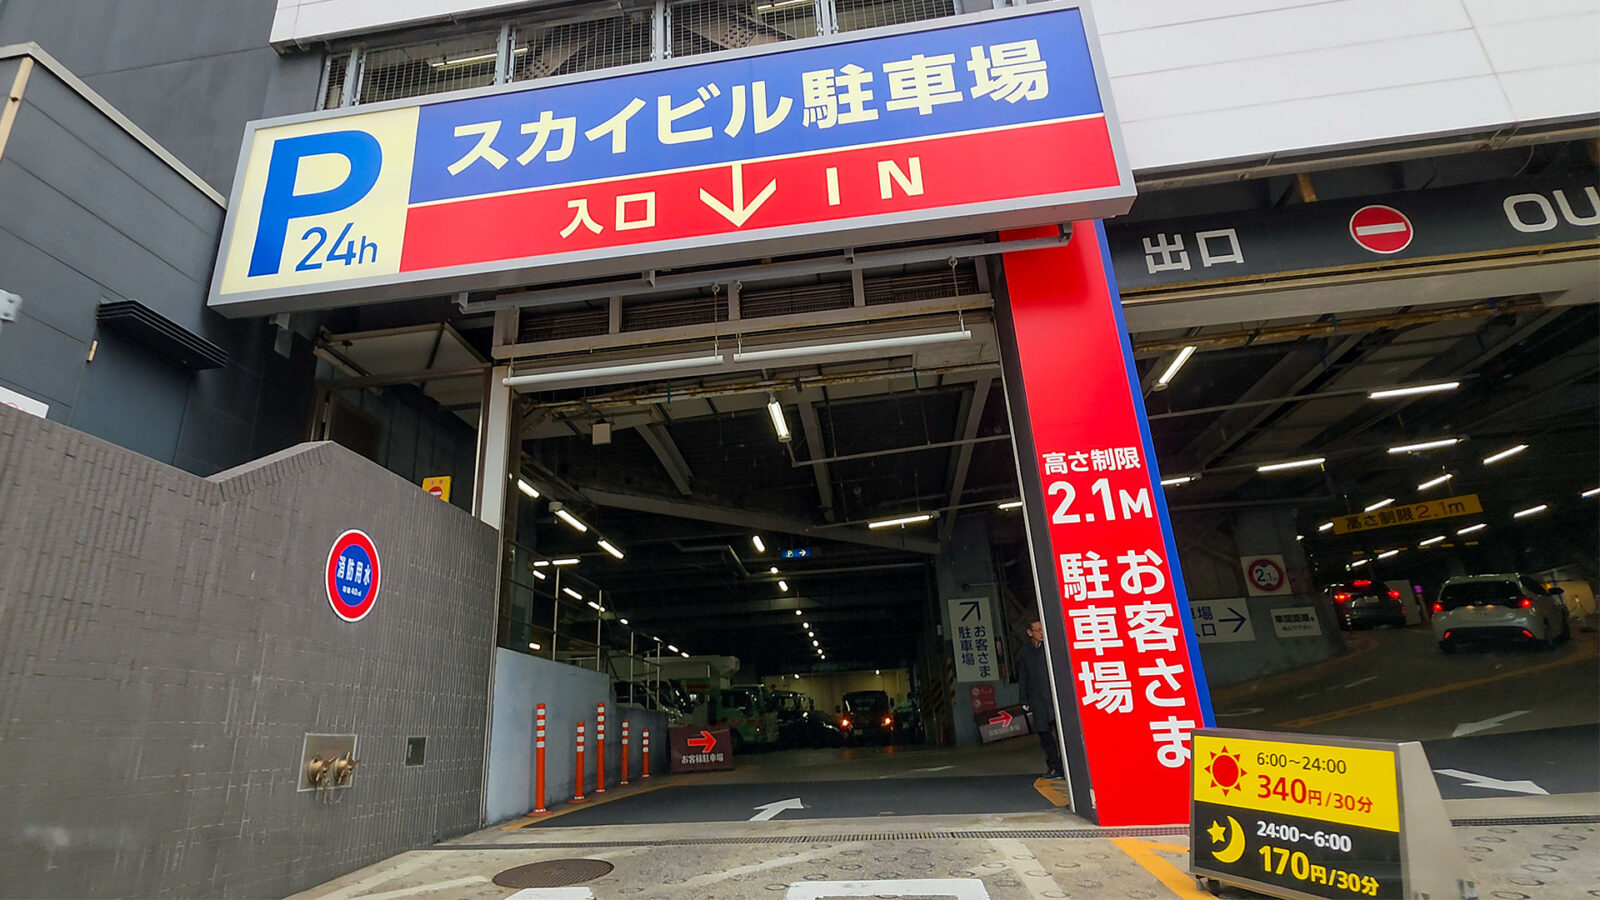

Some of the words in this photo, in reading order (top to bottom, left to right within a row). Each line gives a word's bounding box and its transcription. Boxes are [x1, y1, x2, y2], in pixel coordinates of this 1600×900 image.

[447, 39, 1049, 177] スカイビル駐車場
[247, 129, 383, 278] P
[559, 191, 656, 239] 入口
[825, 156, 924, 206] IN
[294, 222, 378, 272] 24h
[1142, 227, 1245, 274] 出口
[1042, 446, 1141, 475] 高さ制限
[1047, 478, 1153, 524] 2.1M
[336, 555, 371, 586] 消防用水
[958, 626, 975, 665] 駐車場
[974, 625, 991, 678] お客さま
[1060, 551, 1134, 715] 駐車場
[1196, 623, 1216, 637] 口
[1116, 548, 1196, 768] お客さま
[1256, 751, 1347, 774] 6:00～24:00
[1257, 774, 1374, 814] 340円/30分
[1256, 820, 1352, 853] 24:00～6:00
[1258, 844, 1380, 897] 170円/30分
